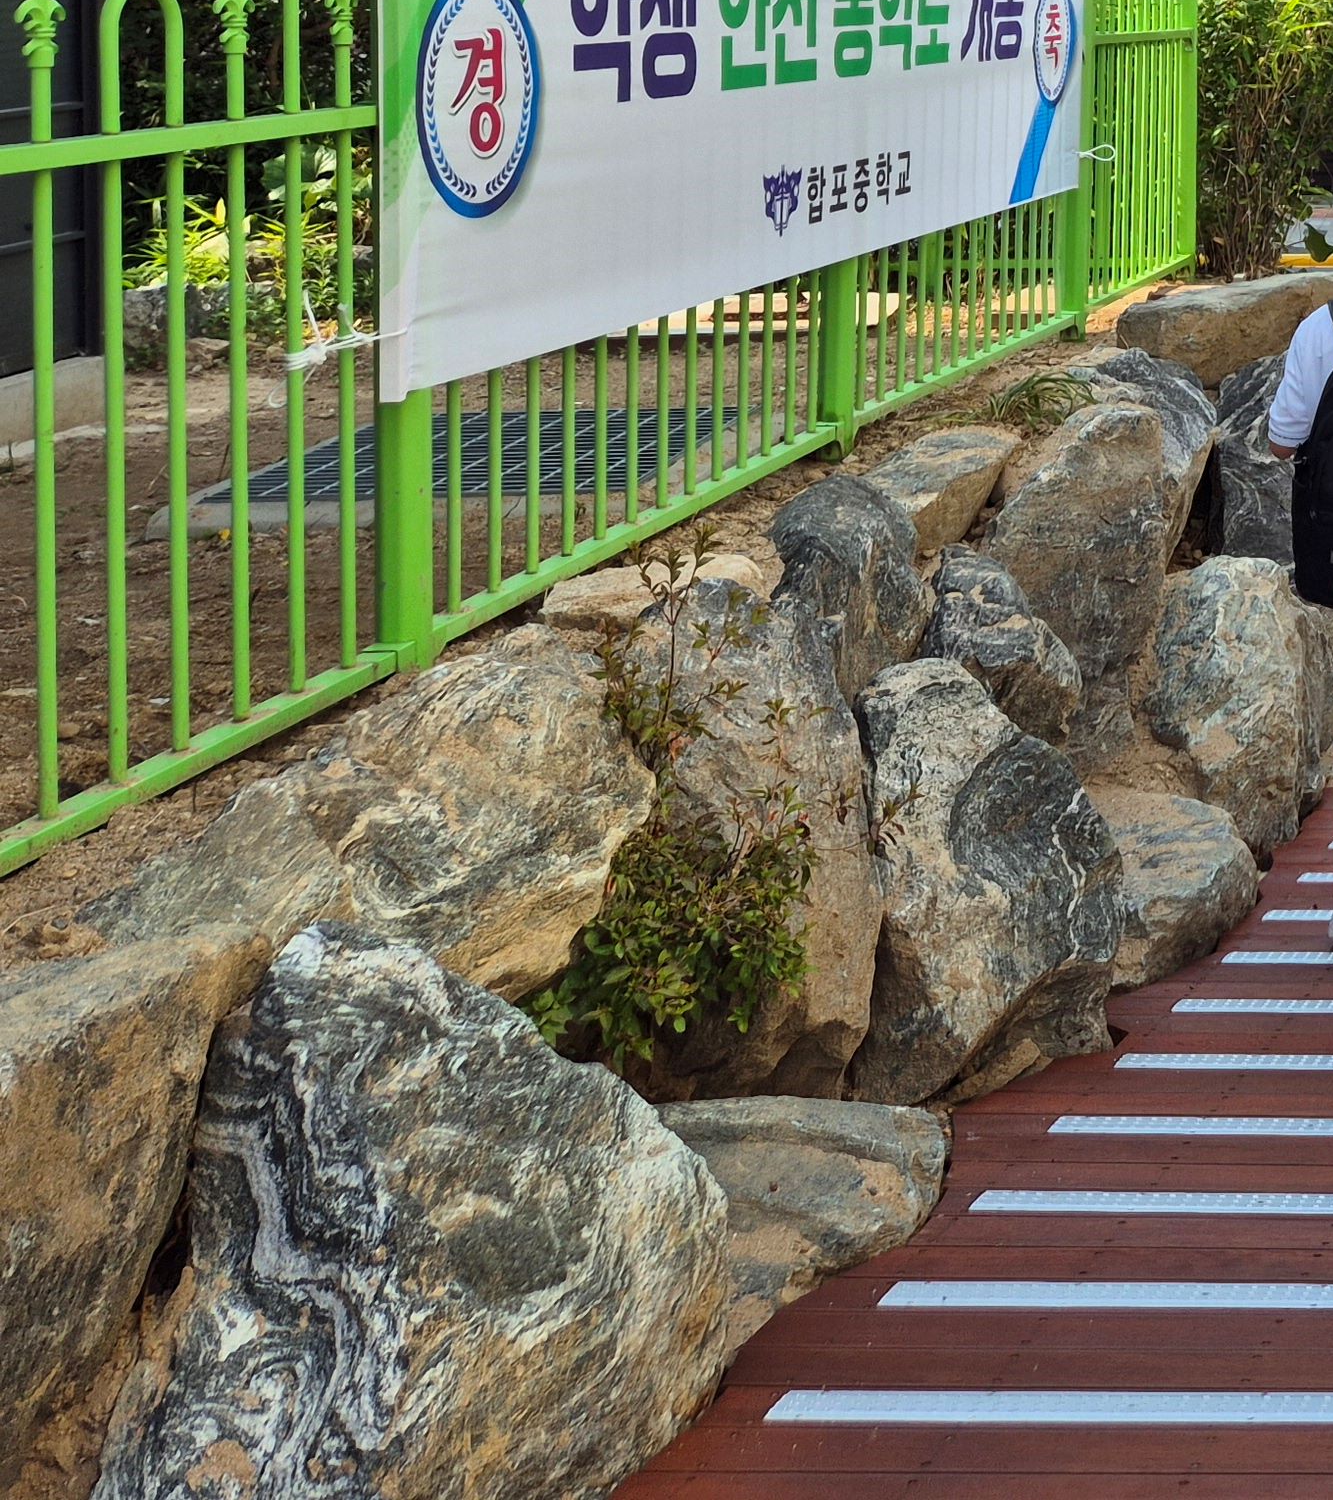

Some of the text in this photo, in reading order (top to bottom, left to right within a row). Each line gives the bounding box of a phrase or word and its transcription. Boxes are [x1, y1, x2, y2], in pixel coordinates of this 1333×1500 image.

[1044, 3, 1063, 63] 축
[452, 29, 507, 157] 경
[807, 151, 912, 224] 합포중학교
